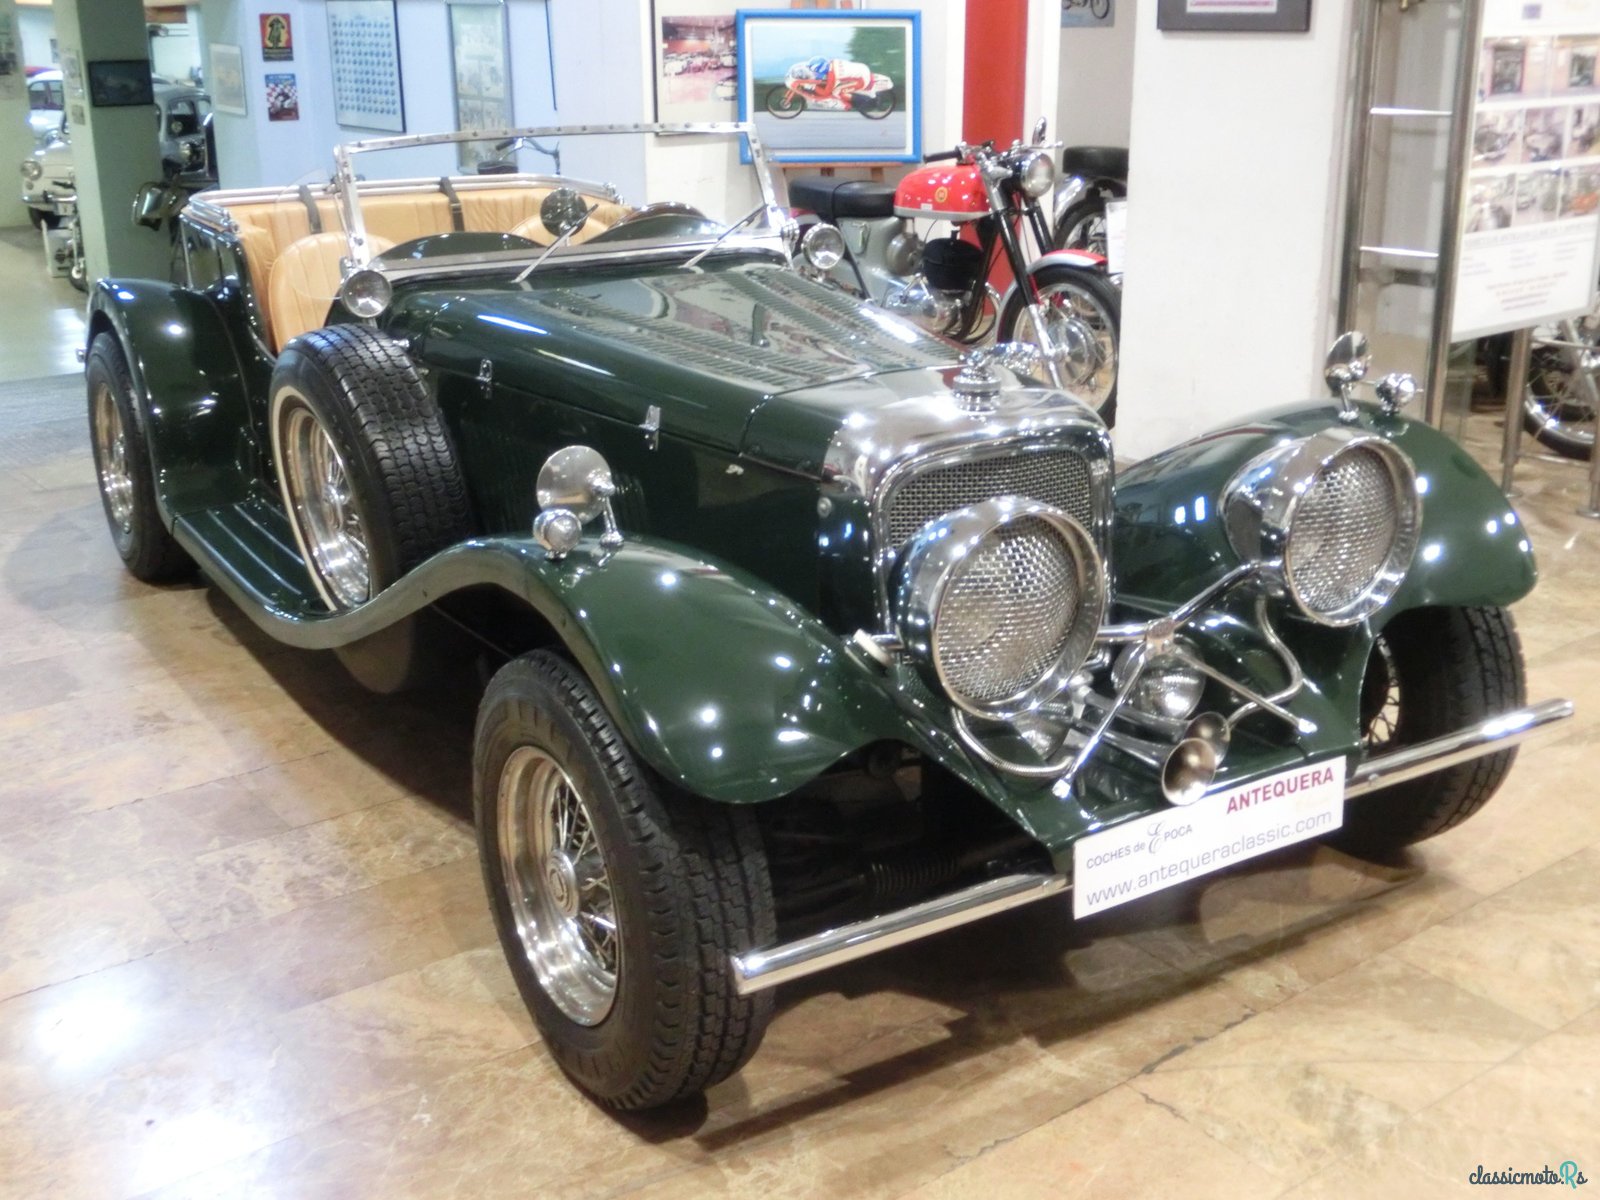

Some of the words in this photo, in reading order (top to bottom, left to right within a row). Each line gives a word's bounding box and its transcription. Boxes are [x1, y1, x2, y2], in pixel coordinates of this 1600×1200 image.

[1226, 766, 1334, 815] ANTEQUERA
[1086, 845, 1132, 870] COCHES
[1133, 841, 1146, 853] de
[1086, 811, 1332, 906] www.antequeraclassic.com
